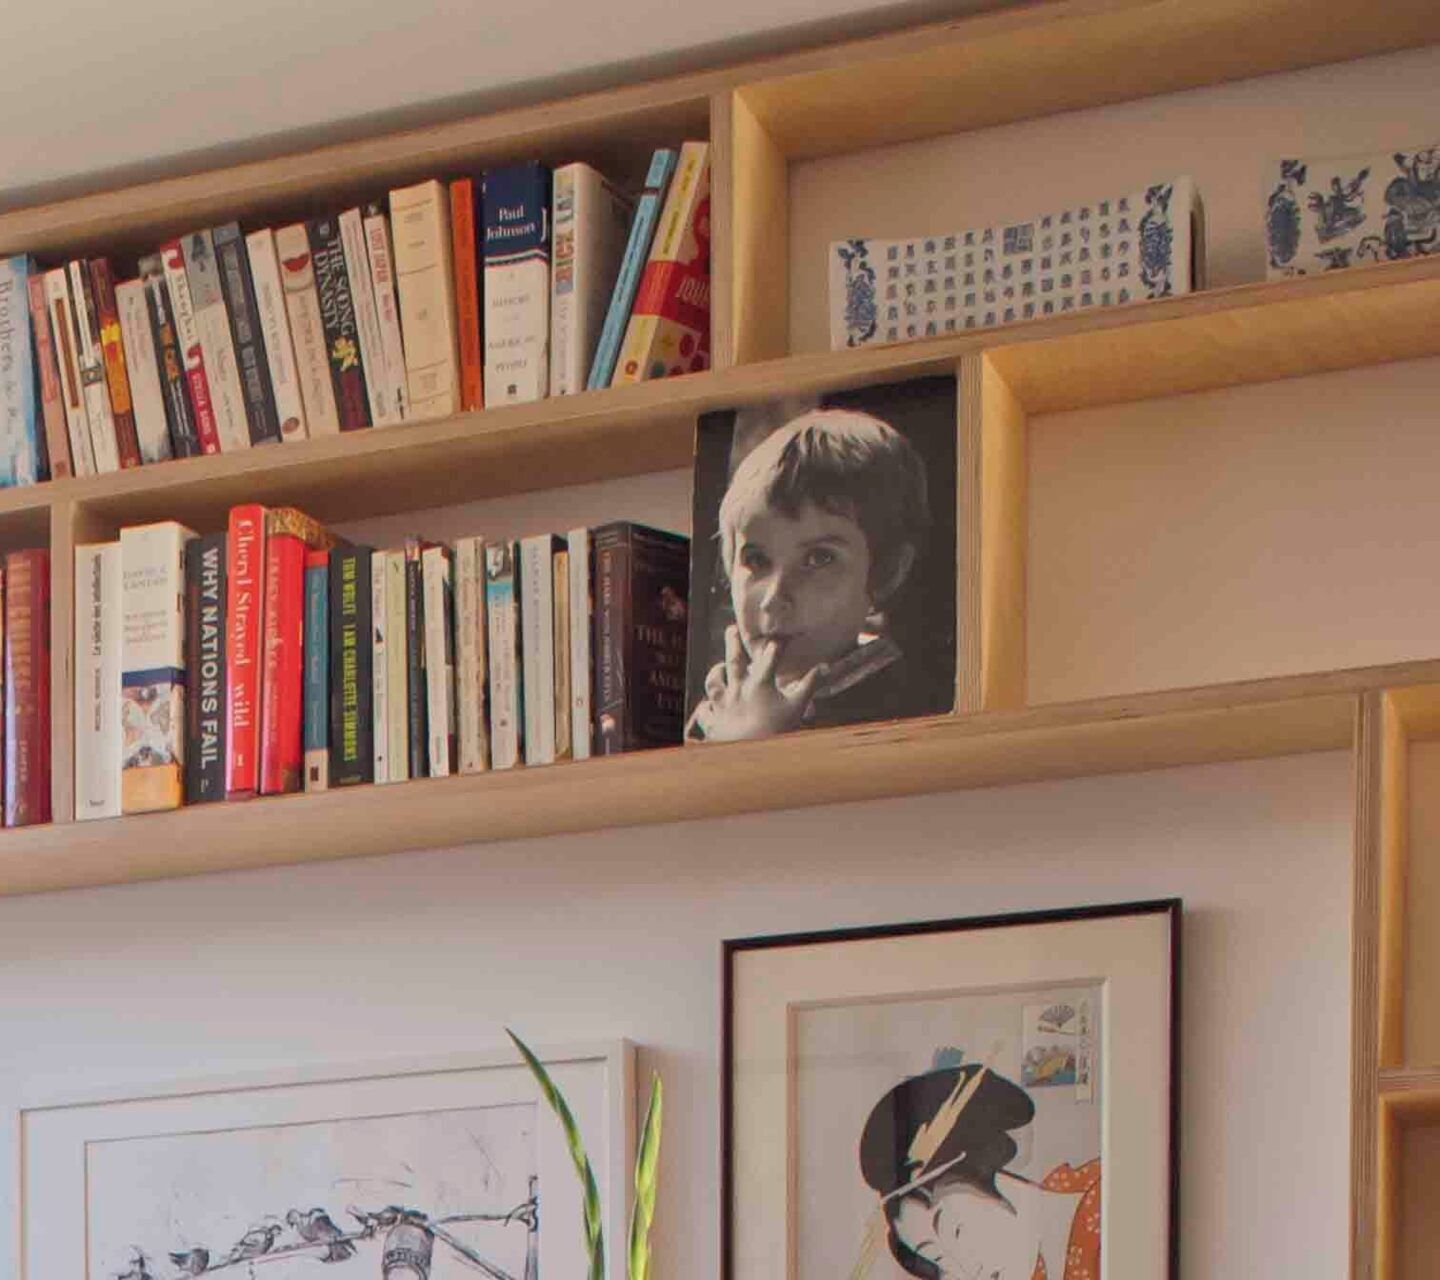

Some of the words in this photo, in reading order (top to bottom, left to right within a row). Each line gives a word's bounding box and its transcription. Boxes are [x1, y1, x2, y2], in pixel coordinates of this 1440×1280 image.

[486, 223, 535, 240] Johnson
[499, 205, 525, 220] Paul
[325, 238, 345, 275] THE
[313, 252, 338, 329] DYNASTY
[332, 276, 355, 336] SOONG
[202, 548, 218, 600] WHY
[236, 520, 254, 585] Cheryl
[342, 557, 355, 581] TOM
[343, 583, 356, 615] WOLFE
[233, 592, 251, 665] Strayed
[202, 606, 218, 713] NATIONS
[344, 650, 357, 707] CHARLOTTE
[234, 683, 248, 727] wild
[202, 720, 218, 769] FAIL
[344, 712, 357, 761] SIMMONS
